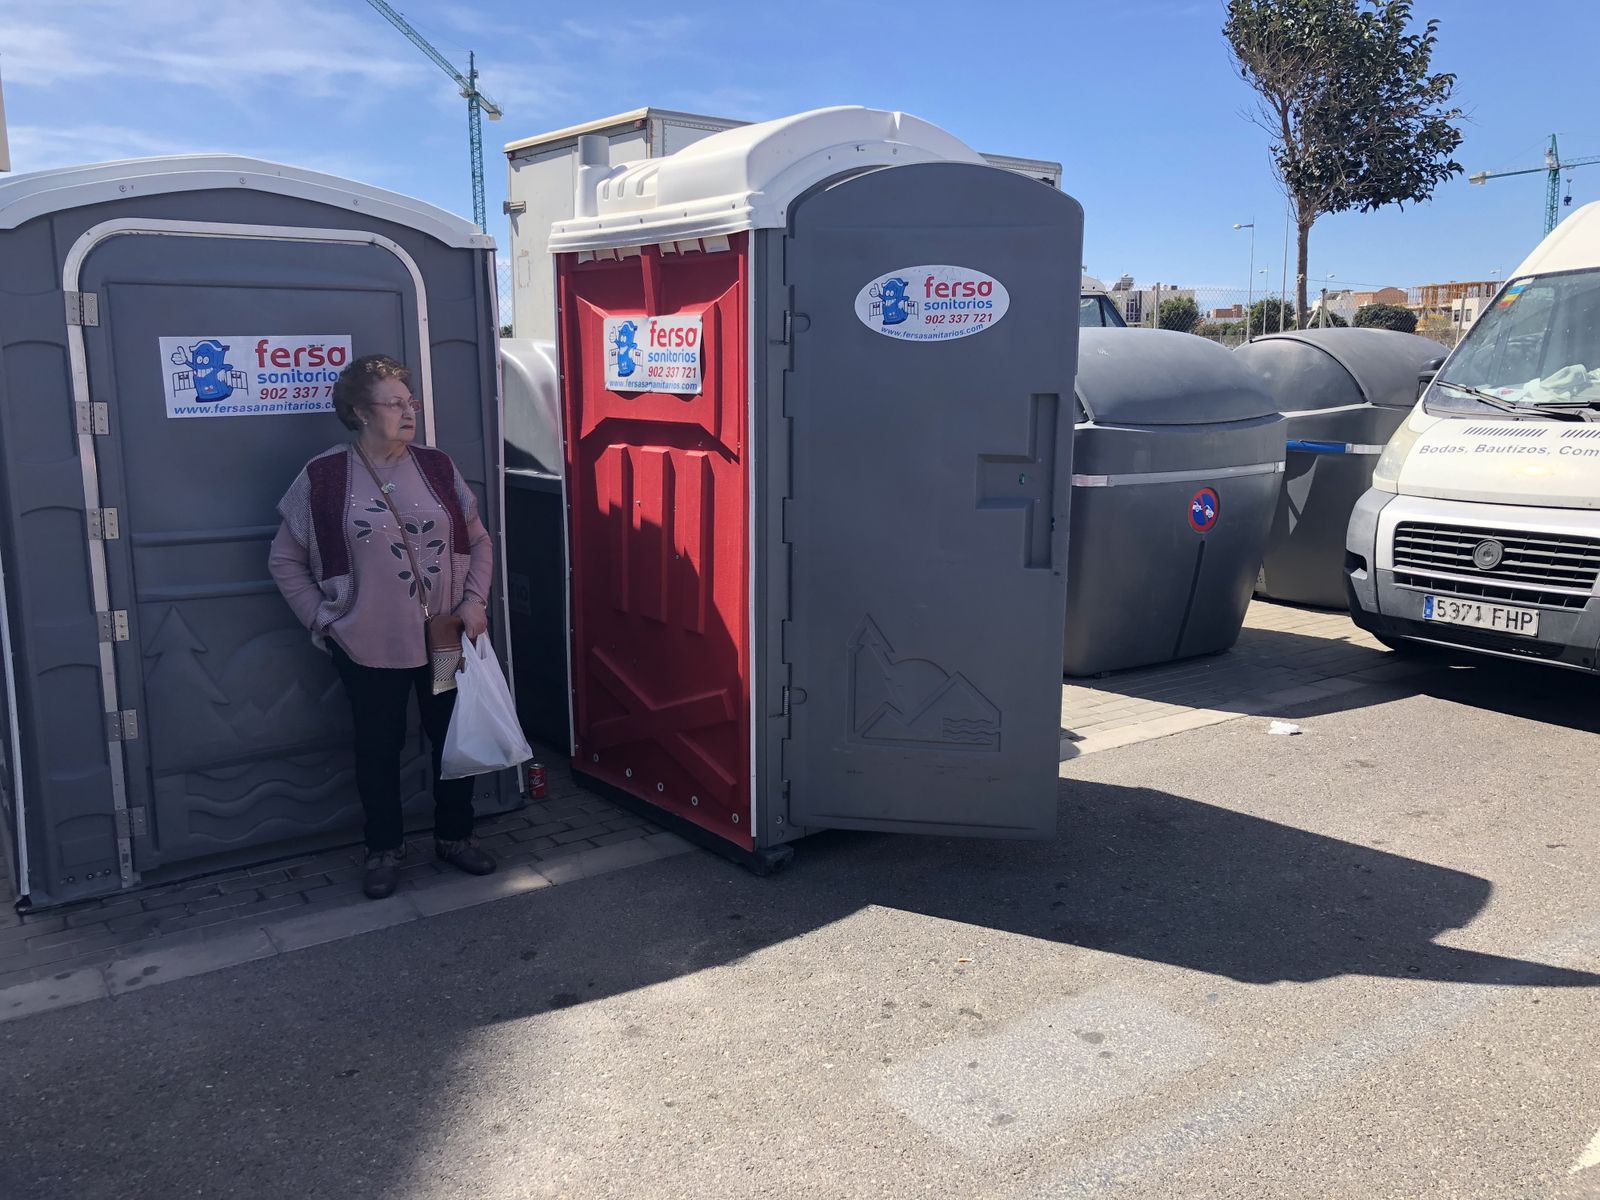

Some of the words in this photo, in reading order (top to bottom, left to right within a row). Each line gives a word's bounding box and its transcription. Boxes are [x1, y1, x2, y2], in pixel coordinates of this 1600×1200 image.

[924, 276, 993, 298] fersa
[924, 298, 993, 311] sanitarios
[925, 314, 945, 325] 902
[948, 314, 969, 324] 337
[973, 313, 993, 323] 721
[649, 320, 698, 348] fersa
[881, 323, 984, 340] www.fersasanitarios.com
[255, 339, 347, 369] fersa
[648, 349, 697, 363] sanitarios
[257, 368, 342, 384] sanitario
[648, 366, 664, 378] 902
[665, 366, 680, 378] 337
[681, 367, 697, 378] 721
[260, 387, 288, 400] 902
[292, 386, 319, 399] 337
[1419, 444, 1469, 455] Bodas,
[1474, 443, 1552, 456] Bautizos,
[1559, 445, 1600, 457] Com
[1437, 600, 1482, 623] 5371
[1491, 607, 1533, 631] FHP
